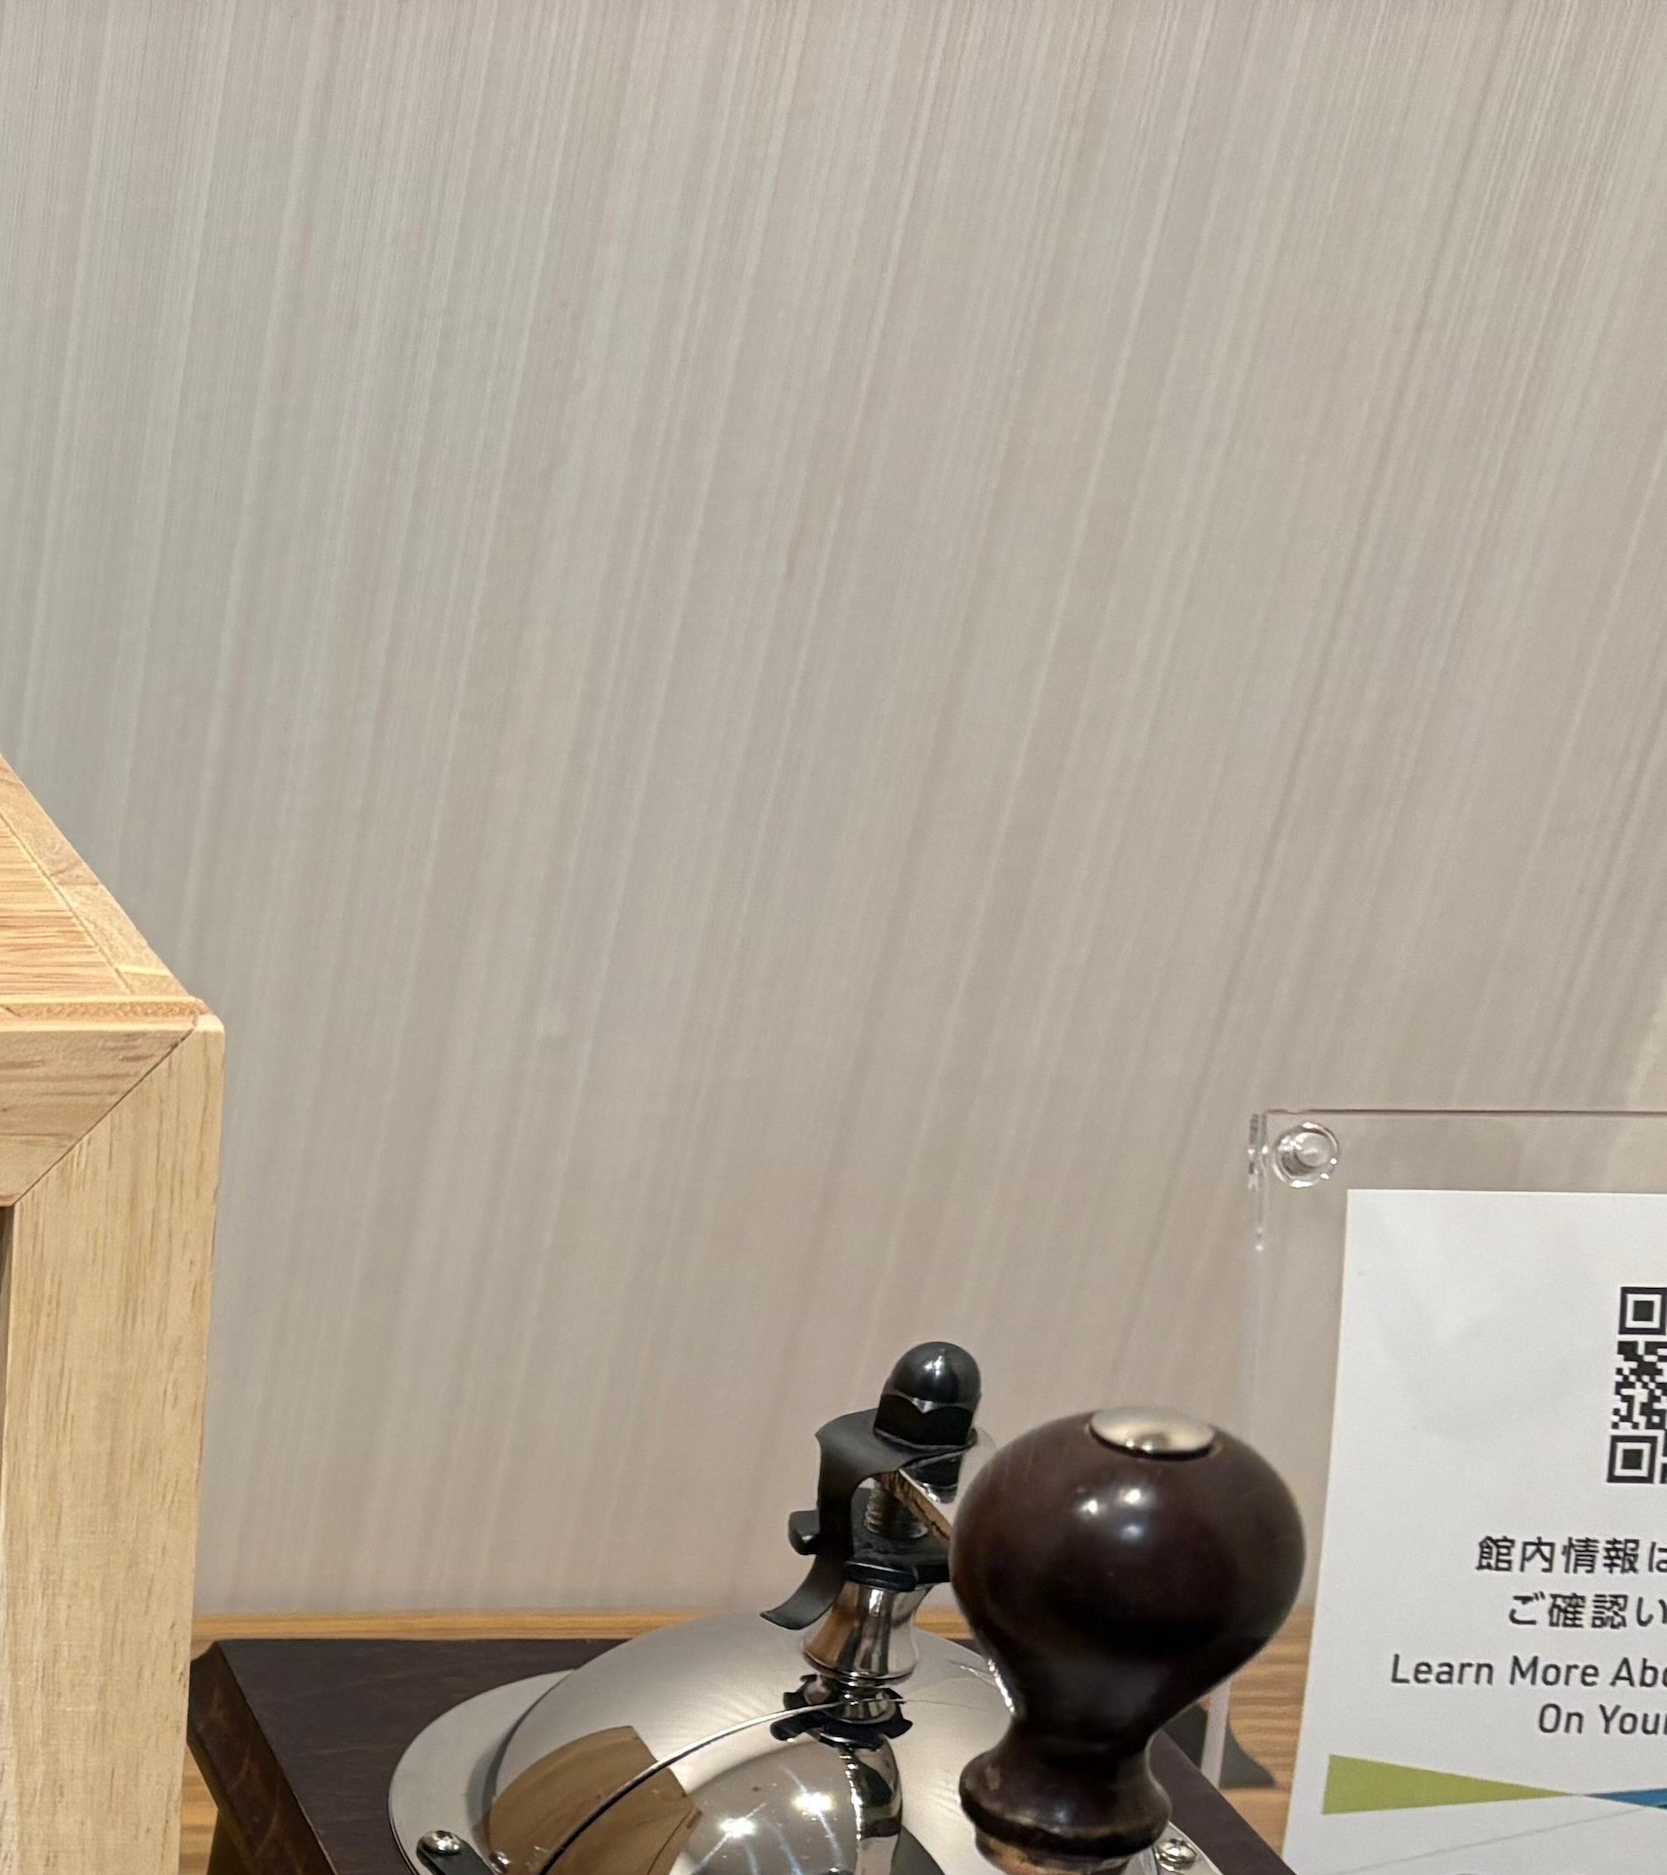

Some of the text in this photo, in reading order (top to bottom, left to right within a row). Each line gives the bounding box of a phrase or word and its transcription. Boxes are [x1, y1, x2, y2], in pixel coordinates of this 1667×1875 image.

[1508, 1591, 1667, 1630] ご確認い
[1390, 1653, 1494, 1686] Learn
[1509, 1654, 1600, 1687] More
[1538, 1702, 1584, 1734] On
